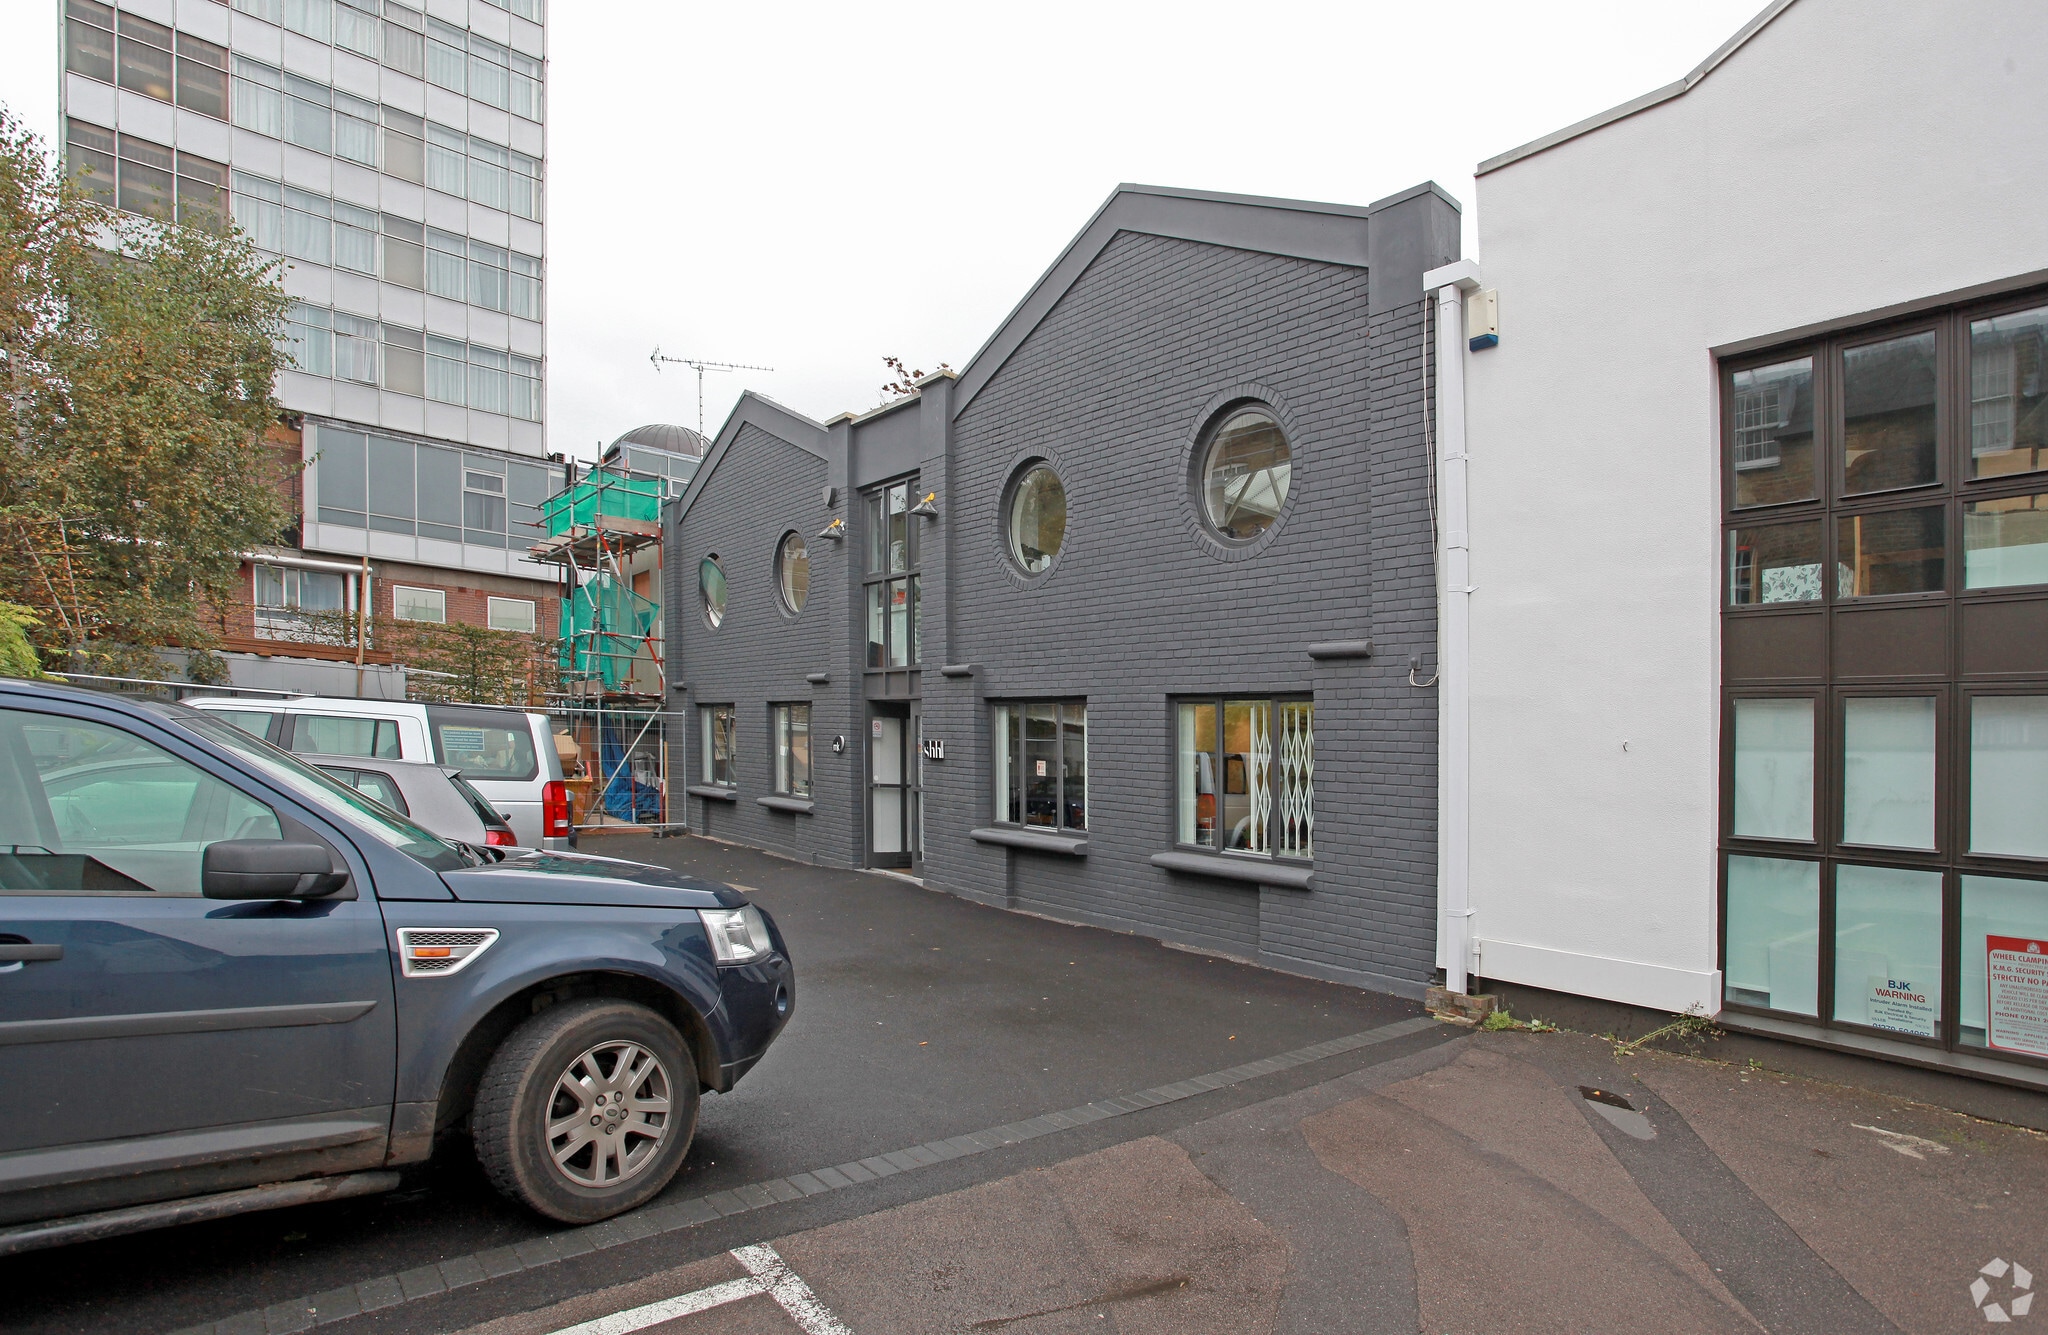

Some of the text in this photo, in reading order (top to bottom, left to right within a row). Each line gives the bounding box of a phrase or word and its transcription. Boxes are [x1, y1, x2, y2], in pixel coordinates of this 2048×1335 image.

[1992, 952, 2016, 961] WHEEL
[2015, 966, 2045, 977] SECURITY
[1888, 979, 1911, 991] BJK
[1992, 973, 2025, 984] STRICTLY
[2027, 977, 2040, 985] NO
[1875, 987, 1926, 1004] WARNING
[1869, 997, 1891, 1006] Intruder
[1909, 1003, 1933, 1012] Installed
[1995, 1011, 2019, 1019] PHONE
